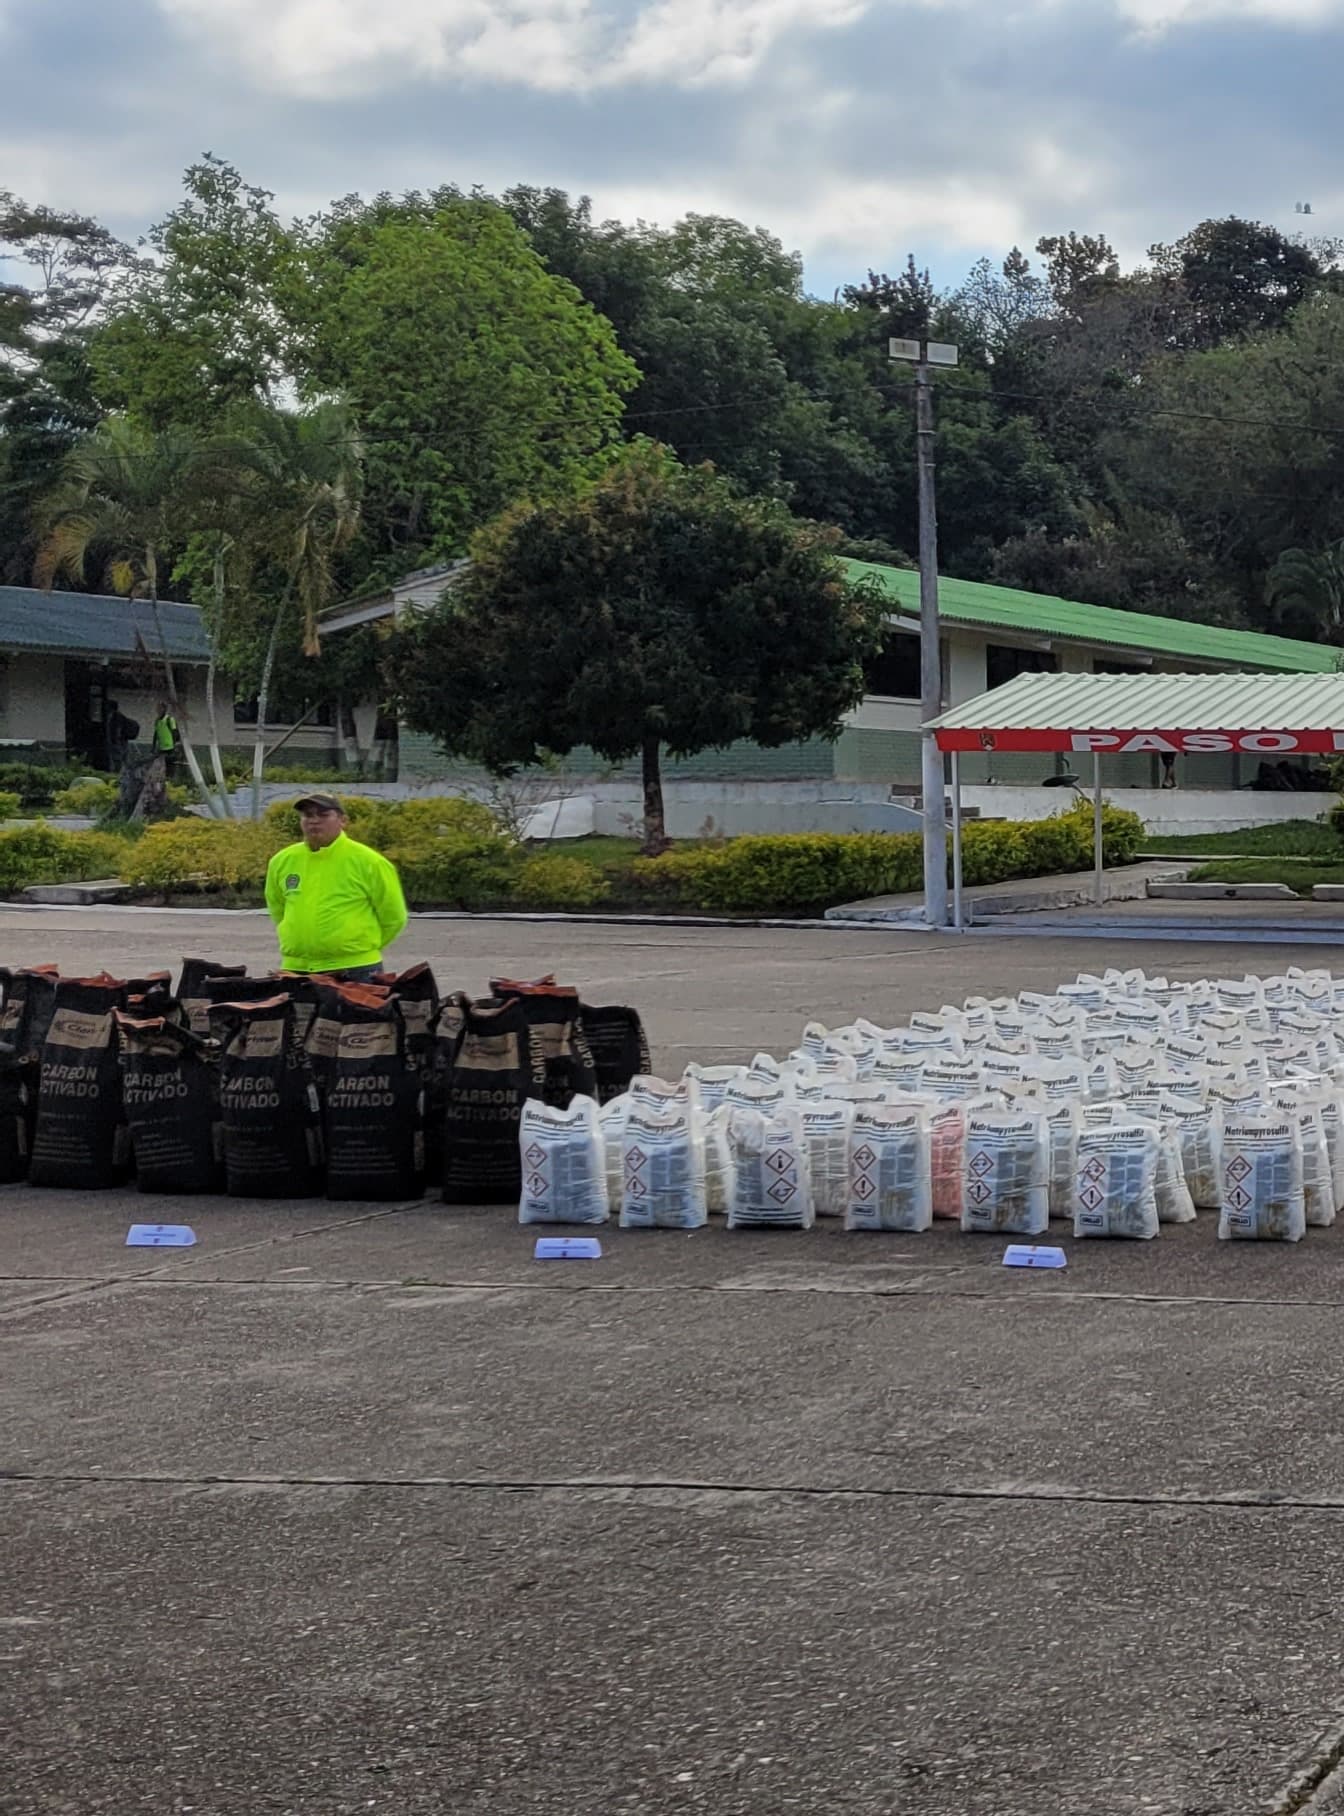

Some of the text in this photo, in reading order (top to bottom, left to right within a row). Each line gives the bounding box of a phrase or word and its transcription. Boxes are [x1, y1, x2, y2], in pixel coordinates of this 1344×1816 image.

[1071, 733, 1299, 752] PASO
[40, 1080, 100, 1098] CTIVADO
[335, 1074, 391, 1092] ARBON
